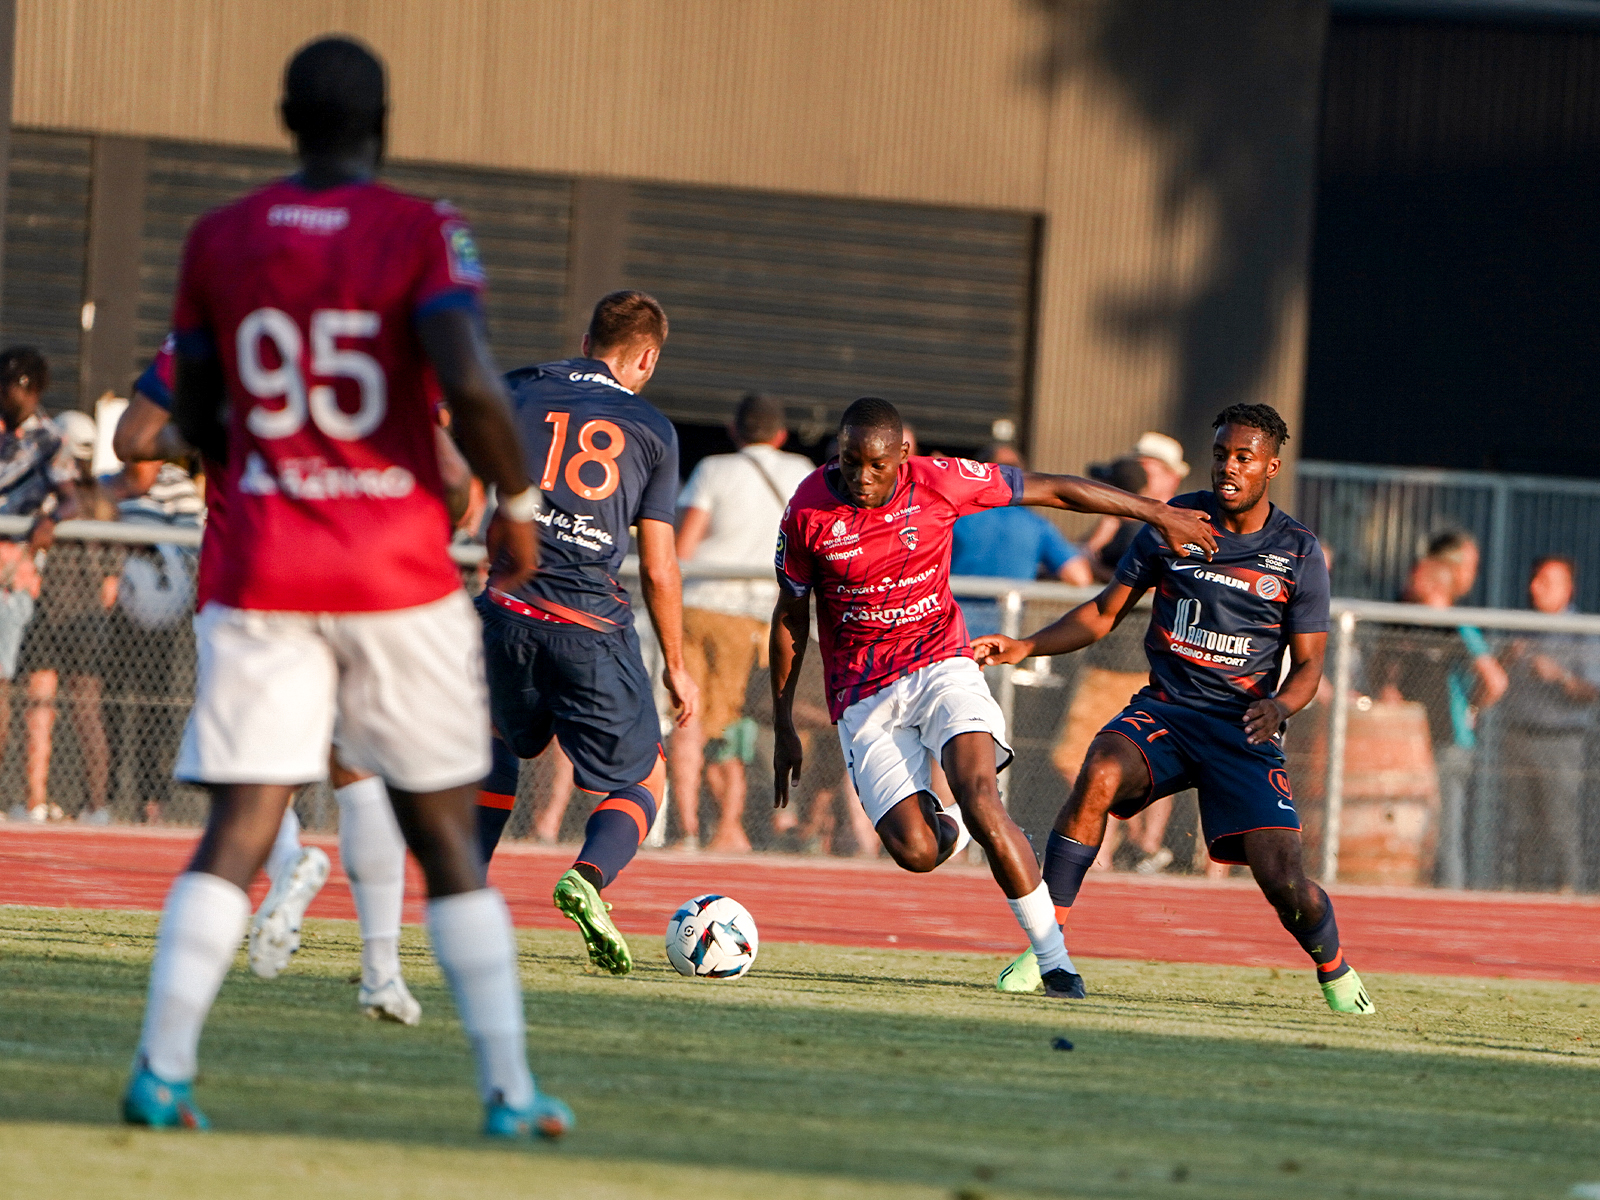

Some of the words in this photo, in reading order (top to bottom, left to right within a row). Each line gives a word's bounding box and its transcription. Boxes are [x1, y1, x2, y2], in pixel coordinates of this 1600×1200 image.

[236, 306, 387, 441] 95
[540, 411, 626, 501] 18
[553, 513, 572, 529] de
[572, 513, 613, 546] France
[825, 546, 864, 562] uhlsport
[1264, 558, 1284, 567] GOOD
[1268, 553, 1290, 564] SMART
[1265, 563, 1287, 574] THINGS
[1204, 570, 1250, 592] FAUN
[1170, 598, 1253, 656] PARTOUCHE
[1170, 643, 1204, 660] CASINO
[1203, 653, 1212, 662] &
[1211, 654, 1248, 667] SPORT
